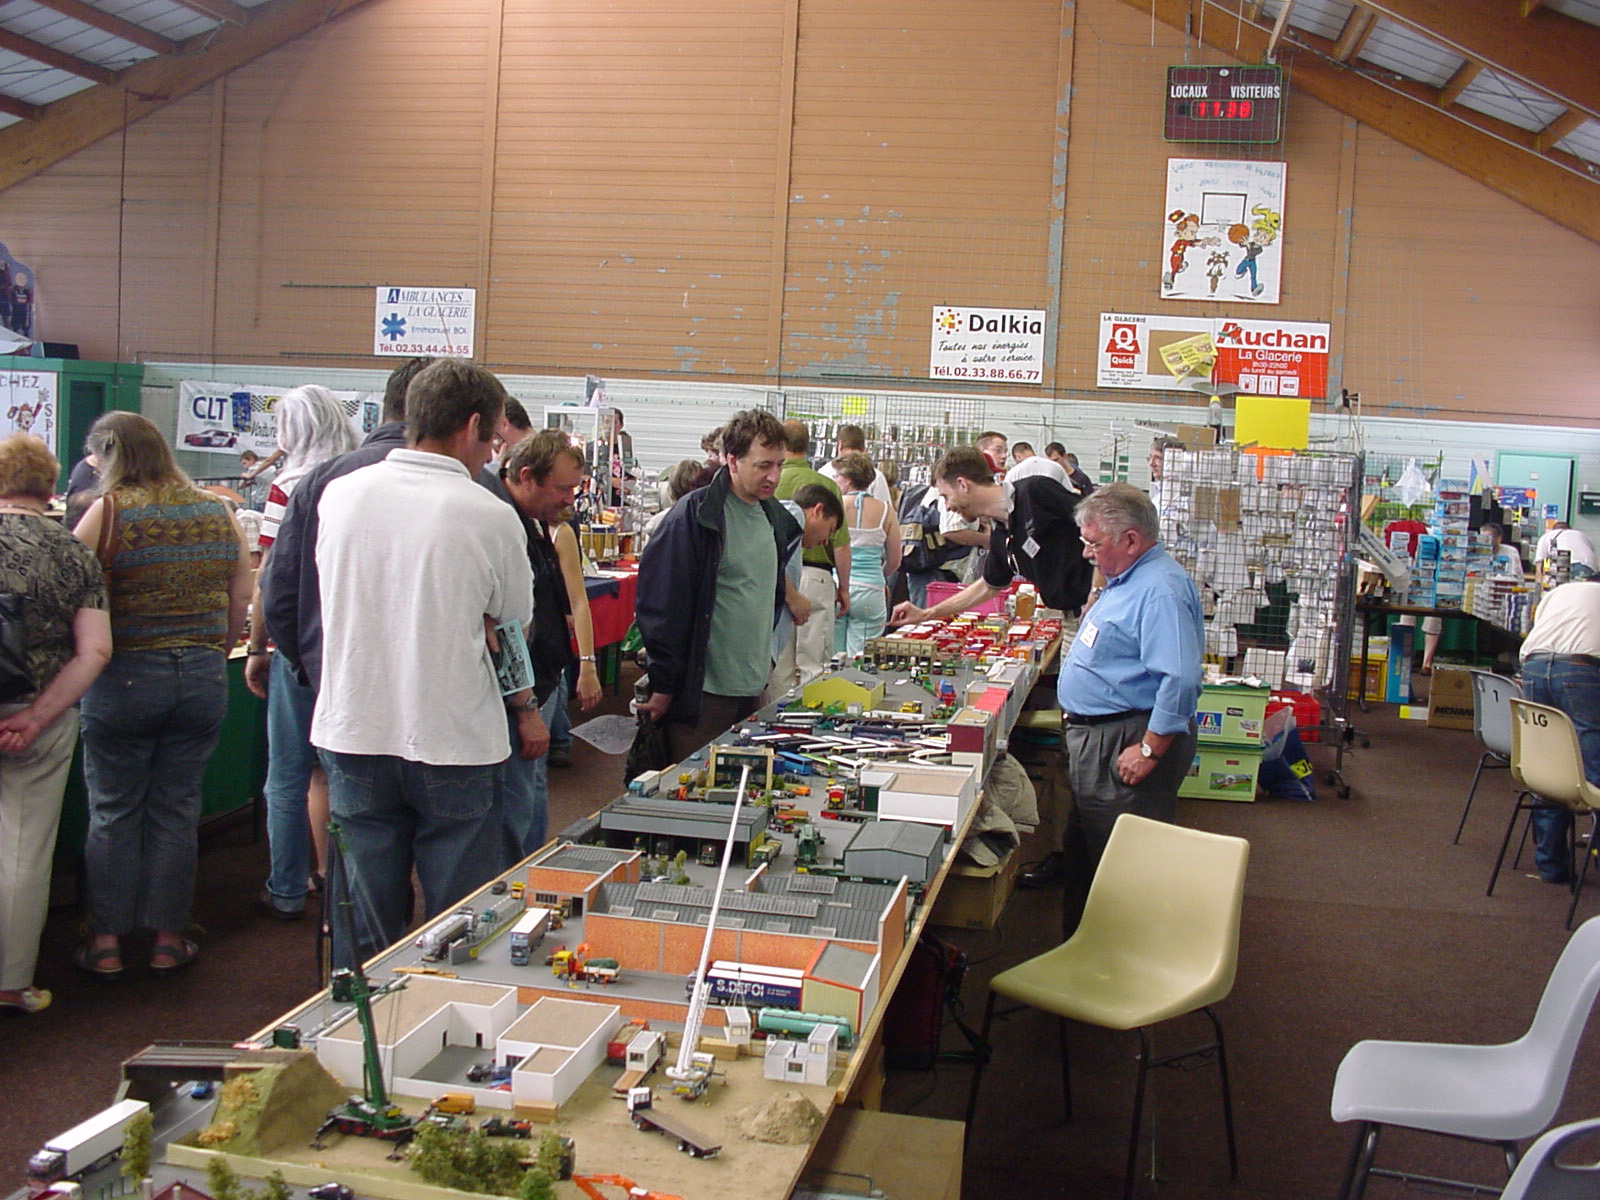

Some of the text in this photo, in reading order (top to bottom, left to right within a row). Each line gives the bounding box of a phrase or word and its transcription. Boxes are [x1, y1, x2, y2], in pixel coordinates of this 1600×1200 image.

[1170, 85, 1280, 99] LOCAUX VISITEURS
[387, 289, 464, 304] AMBULANCES
[408, 306, 470, 318] LA GLACERIE
[969, 313, 1042, 335] Dalkia
[1216, 322, 1326, 350] Auchan
[1111, 356, 1134, 364] Quick
[1238, 349, 1303, 363] La Glacerie
[954, 367, 1040, 380] 02.33.88.66.77
[0, 373, 40, 389] CHEZ
[192, 396, 229, 420] CLT
